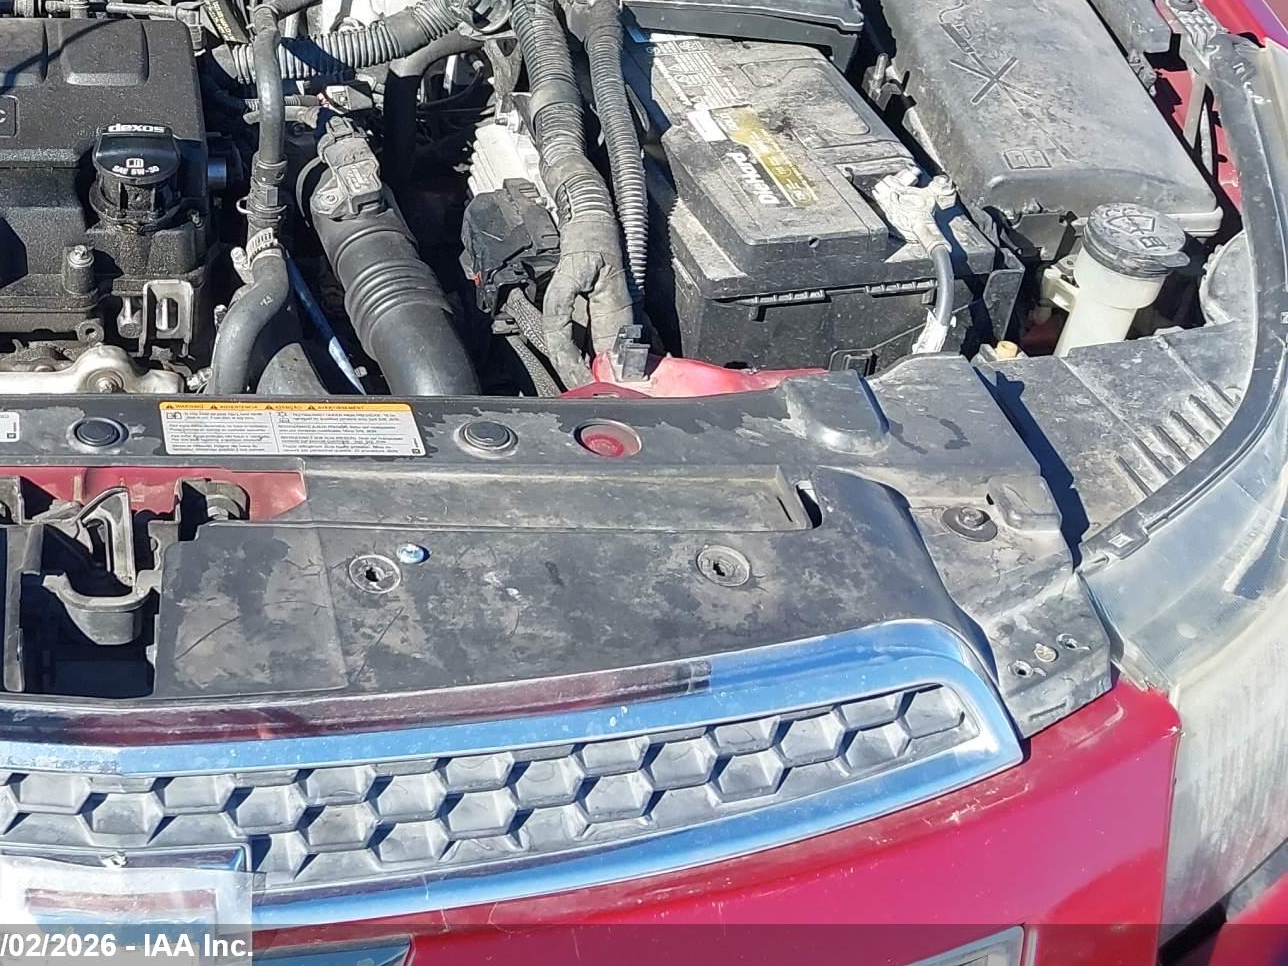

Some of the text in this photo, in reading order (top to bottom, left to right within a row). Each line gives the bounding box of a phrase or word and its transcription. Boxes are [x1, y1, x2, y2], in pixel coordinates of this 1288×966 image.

[108, 123, 164, 133] dexos
[130, 165, 160, 175] 5W-30
[725, 151, 781, 205] DieHard
